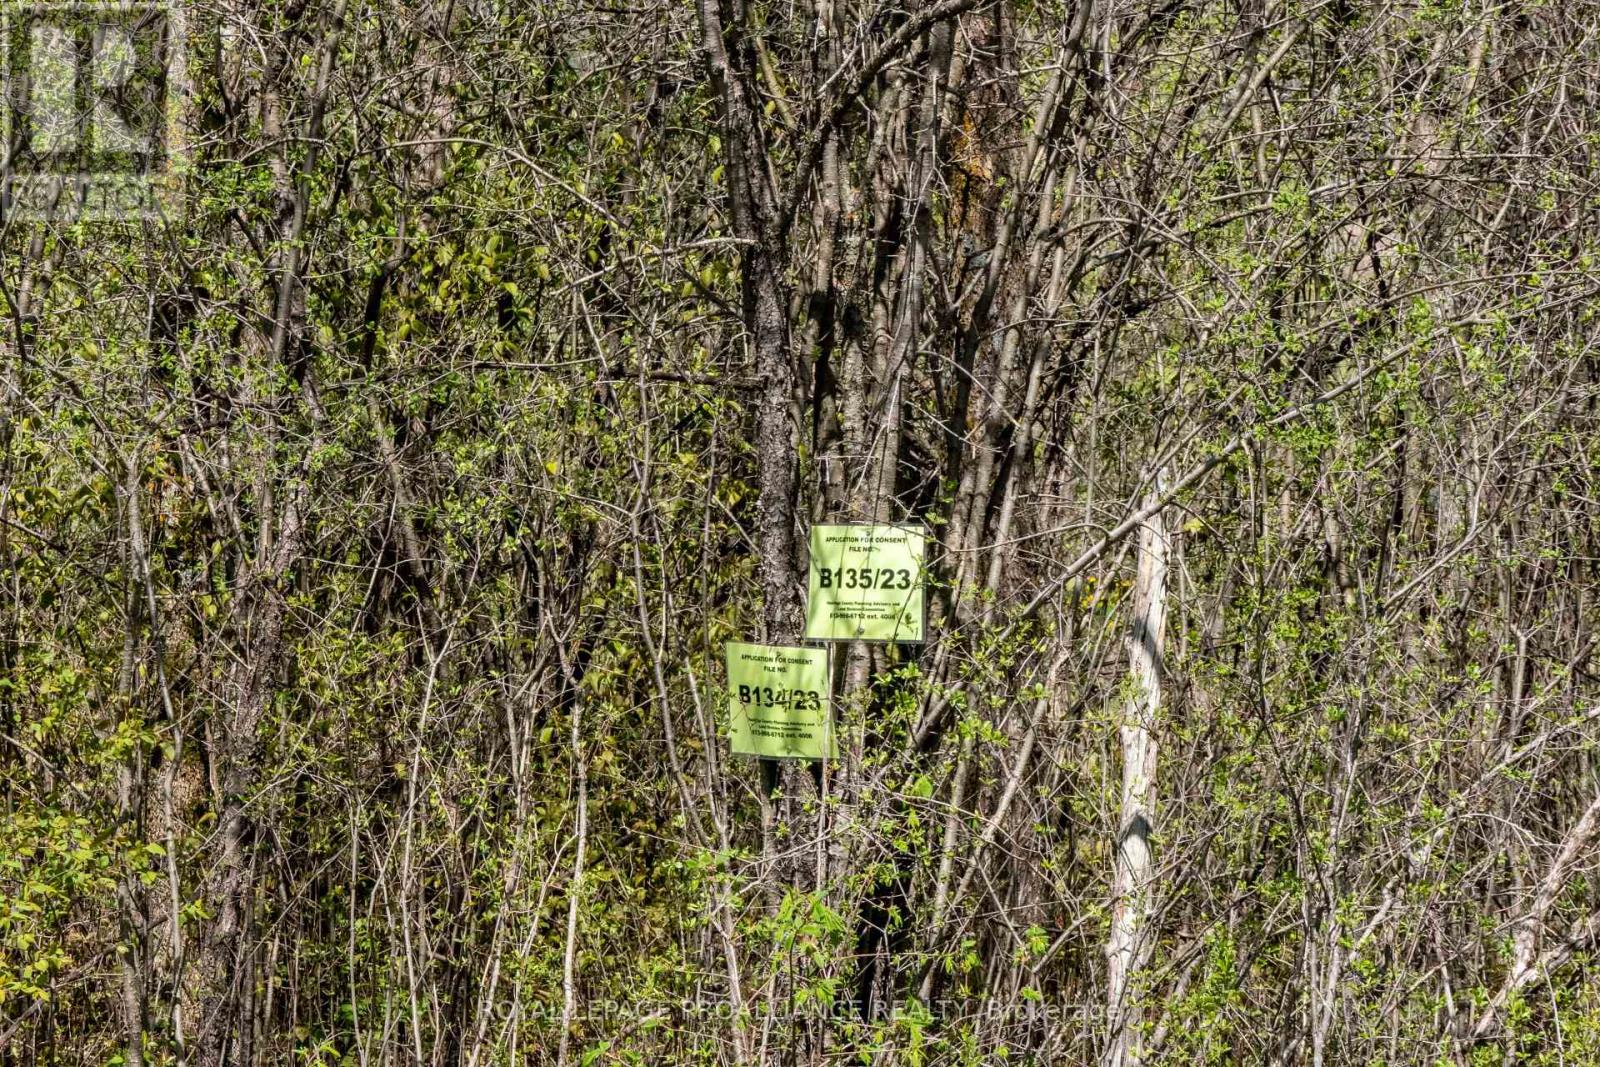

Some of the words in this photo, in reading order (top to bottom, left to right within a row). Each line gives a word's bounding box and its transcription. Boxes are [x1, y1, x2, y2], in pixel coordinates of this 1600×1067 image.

[819, 567, 911, 590] B135/23
[741, 653, 773, 662] APPLICATION
[787, 657, 813, 665] CONSENT
[738, 684, 821, 711] B134/23
